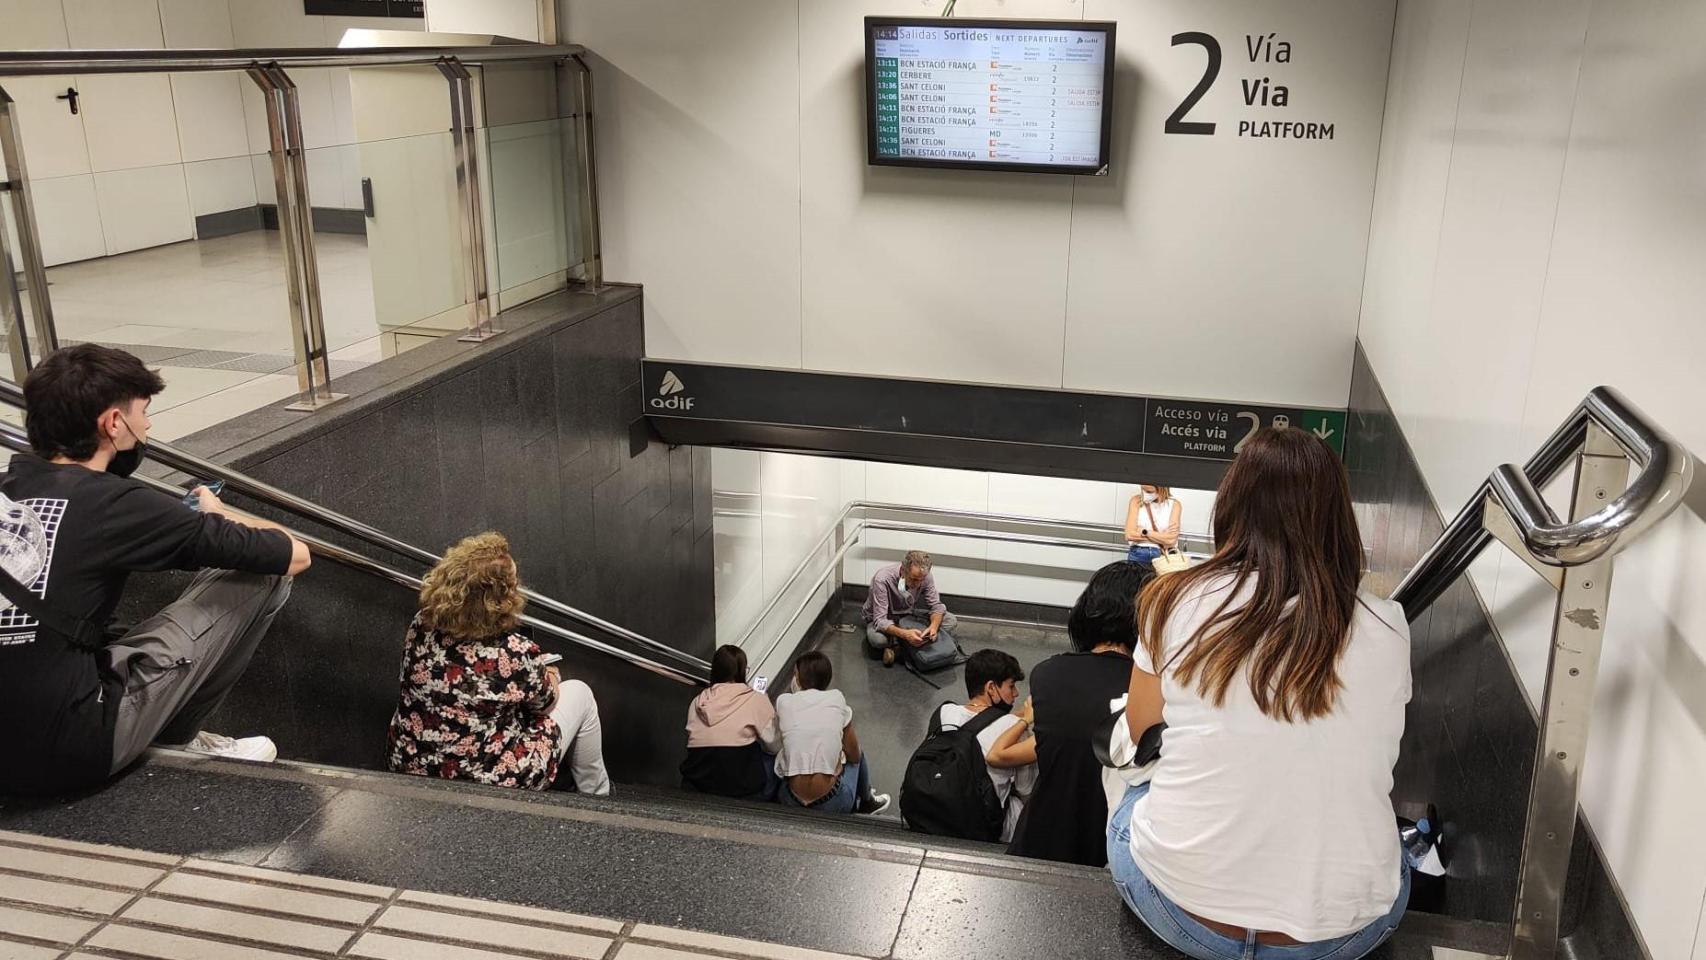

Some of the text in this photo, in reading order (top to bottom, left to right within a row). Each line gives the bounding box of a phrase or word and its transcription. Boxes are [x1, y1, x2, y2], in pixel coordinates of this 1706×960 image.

[899, 30, 937, 40] Salidas
[943, 30, 989, 41] Sortides
[1018, 35, 1068, 43] DEPARTURES
[1246, 32, 1291, 63] Vía
[900, 60, 914, 68] BCN
[917, 60, 945, 68] ESTACIÓ
[948, 61, 977, 70] FRANÇA
[900, 82, 918, 90] SANT
[921, 83, 946, 91] CELONI
[1052, 87, 1057, 95] 2
[1164, 31, 1222, 135] 2
[921, 94, 946, 102] CELONI
[1241, 77, 1289, 107] Via
[917, 104, 945, 113] ESTACIÓ
[948, 106, 977, 115] FRANÇA
[917, 116, 945, 124] ESTACIÓ
[948, 117, 977, 126] FRANÇA
[901, 127, 935, 135] FIGUERES
[1238, 120, 1335, 140] PLATFORM
[901, 137, 919, 145] SANT
[921, 138, 946, 146] CELONI
[918, 148, 945, 157] ESTACIÓ
[948, 150, 976, 159] FRANÇA
[1049, 154, 1054, 162] 2
[651, 396, 695, 410] adif
[1155, 406, 1229, 422] Acceso vía
[1161, 423, 1227, 439] Accés via
[1233, 411, 1260, 454] 2
[1184, 442, 1226, 453] PLATFORM
